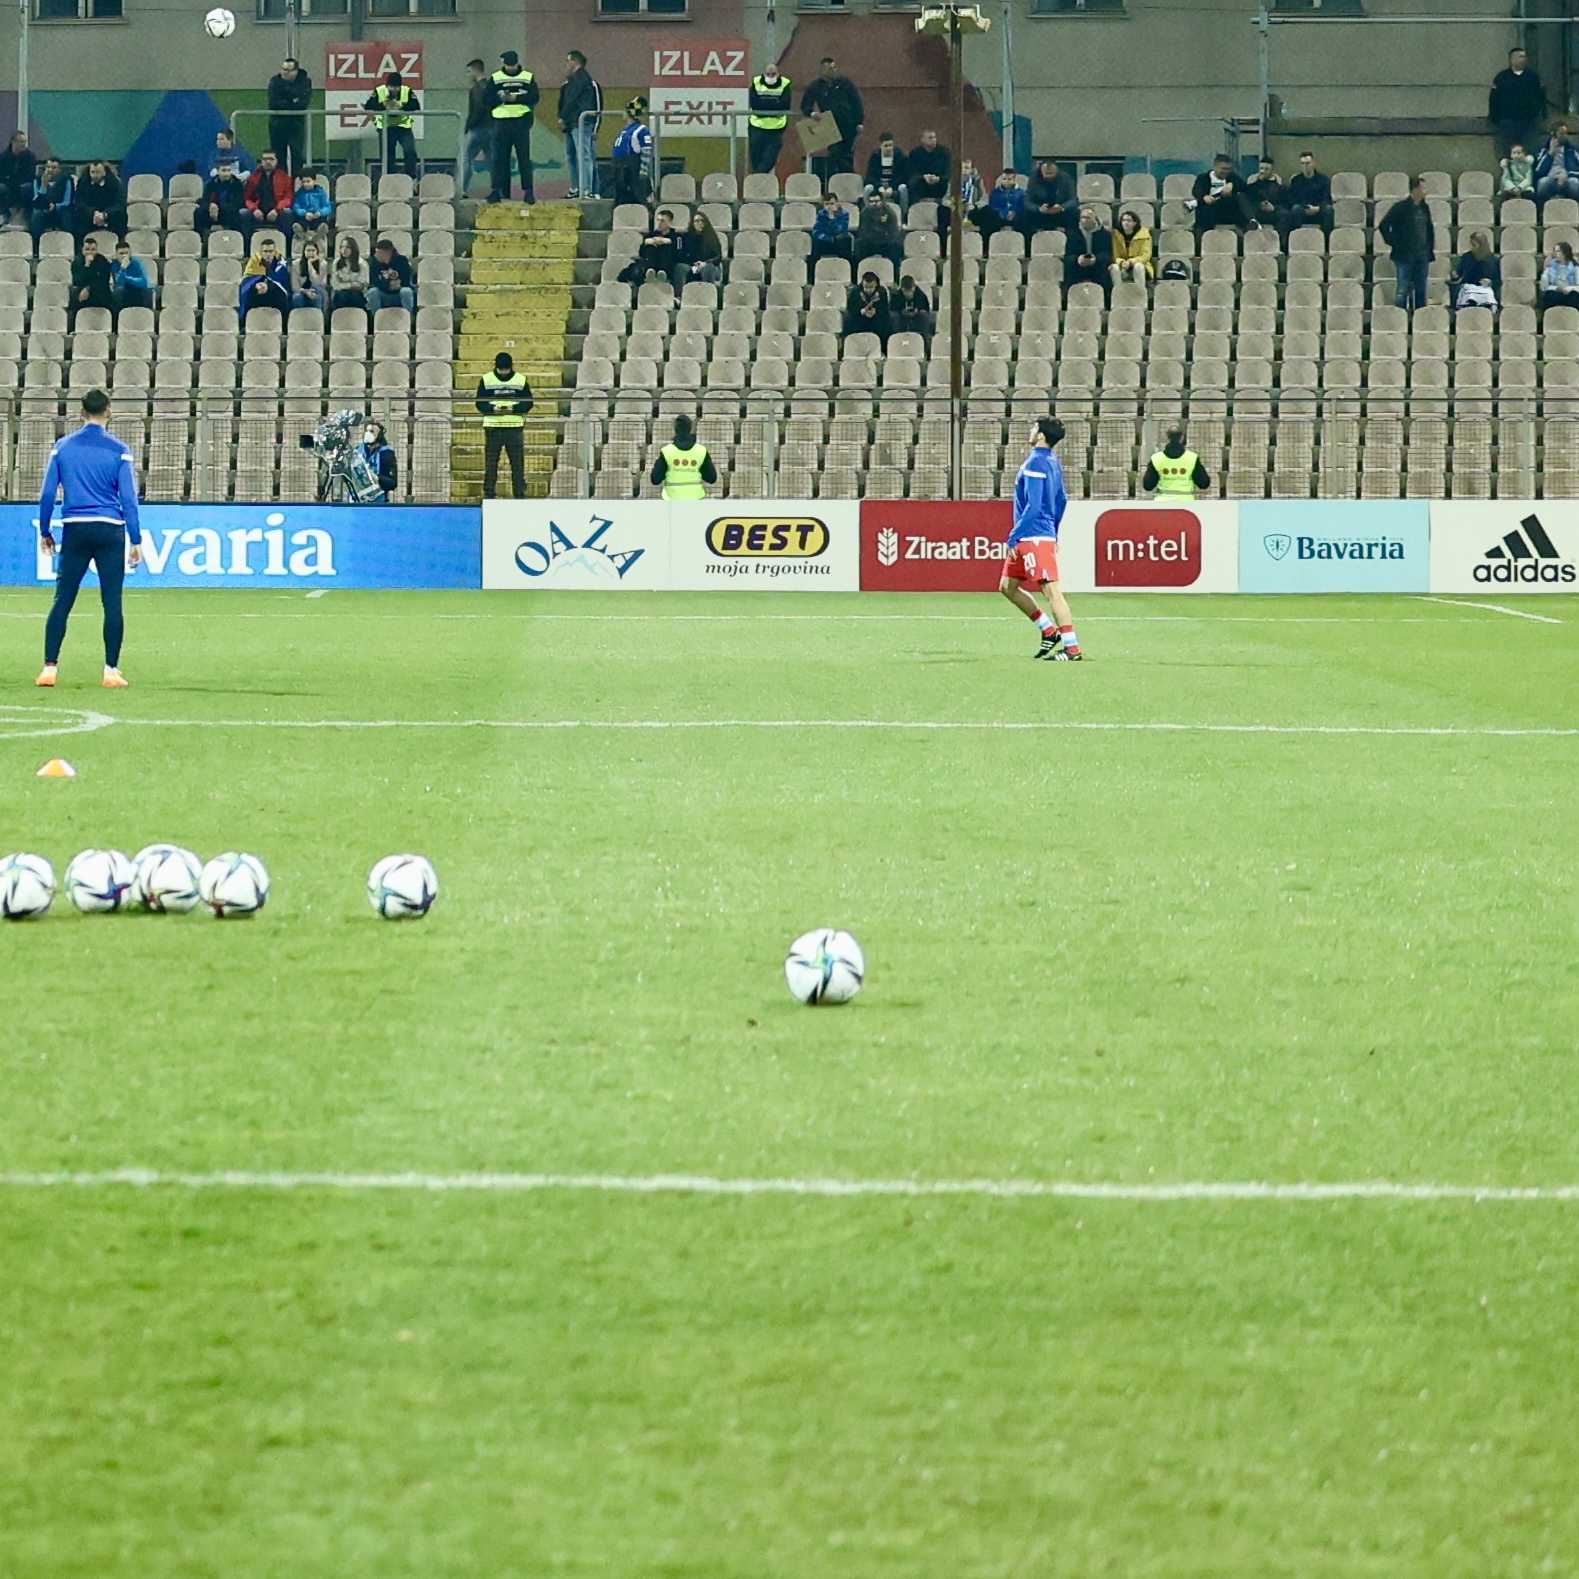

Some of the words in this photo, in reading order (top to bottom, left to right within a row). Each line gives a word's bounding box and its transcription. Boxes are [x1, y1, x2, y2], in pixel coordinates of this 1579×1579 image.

[328, 53, 420, 79] IZLAZ
[654, 50, 745, 76] IZLAZ
[664, 100, 735, 126] EXIT
[514, 513, 646, 580] OAZA
[721, 523, 816, 552] BEST
[904, 535, 971, 561] Ziraat
[1106, 531, 1189, 562] m:tel
[1296, 535, 1405, 560] Bavaria
[704, 560, 750, 578] moja
[754, 560, 831, 578] trgovina
[1473, 558, 1577, 583] adidas
